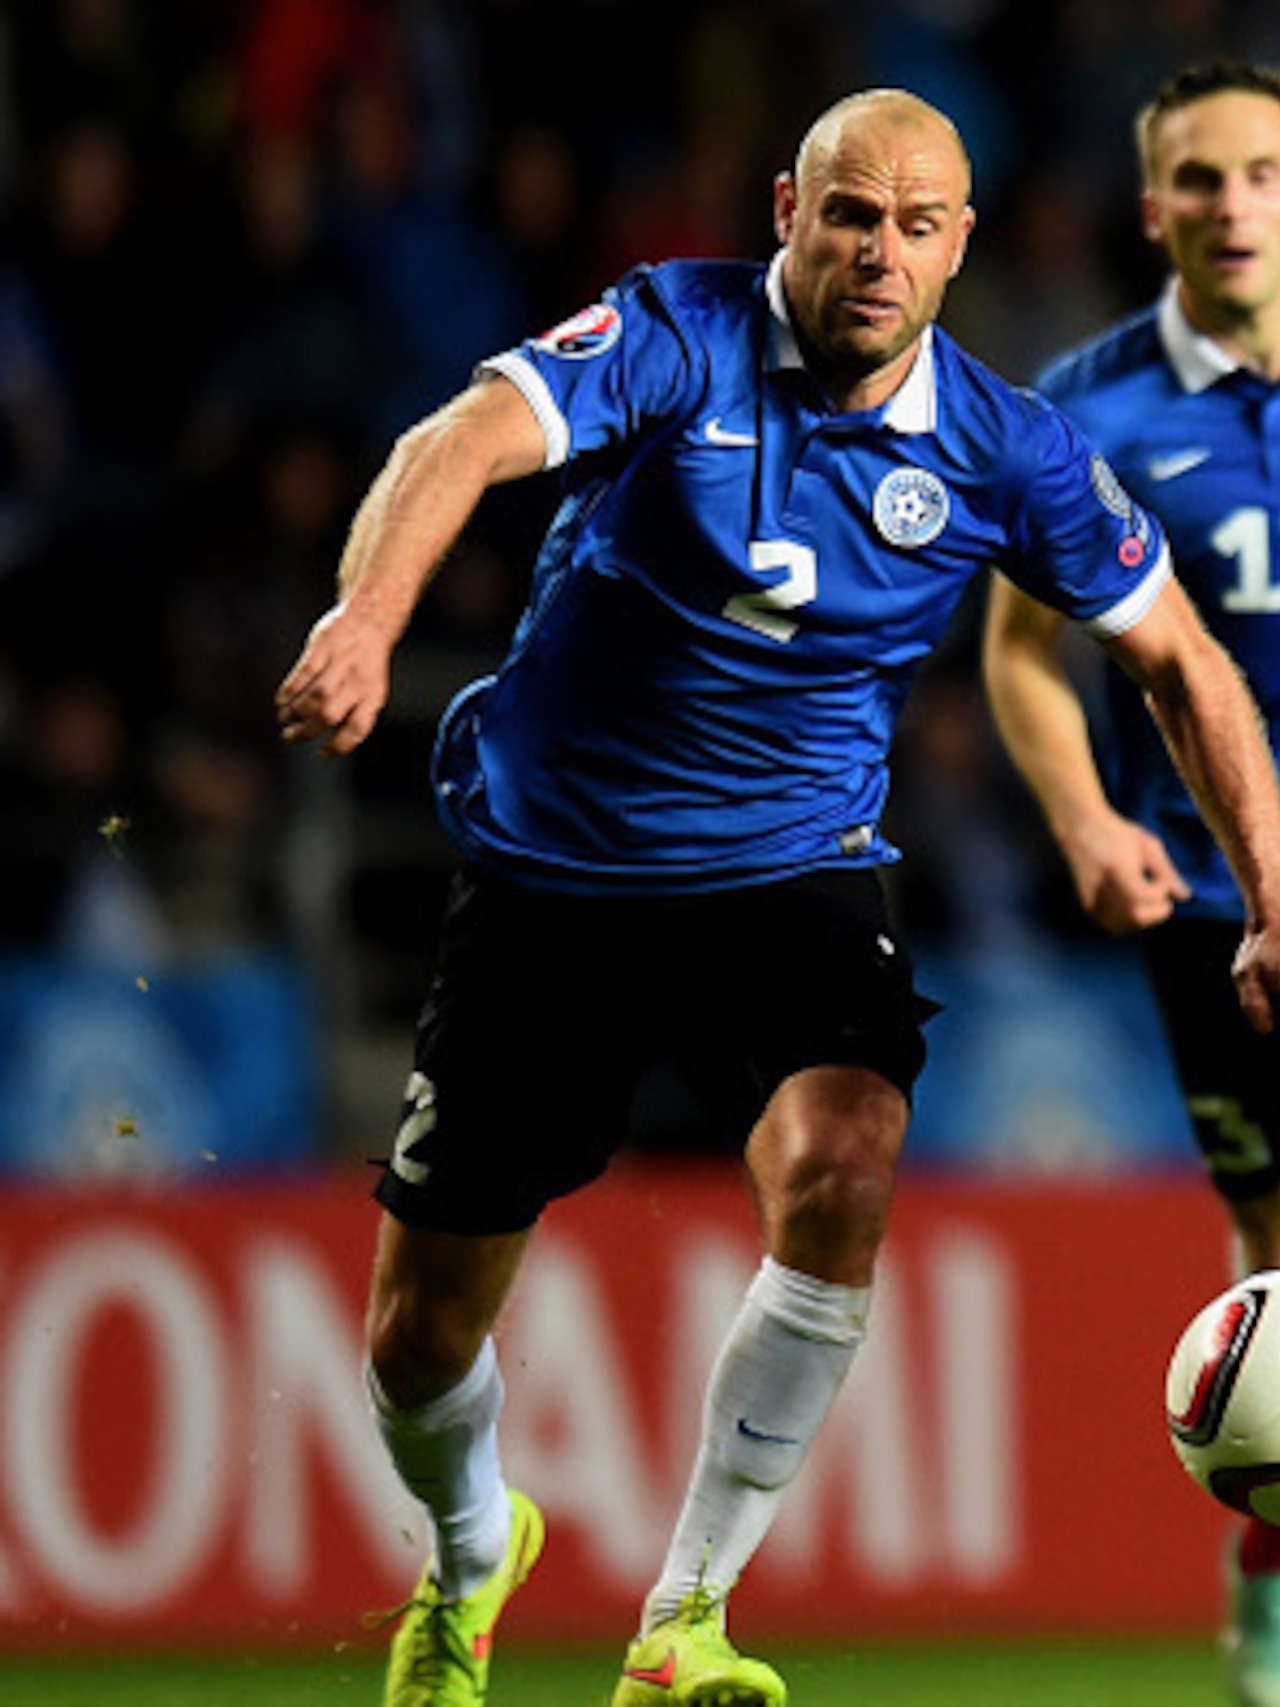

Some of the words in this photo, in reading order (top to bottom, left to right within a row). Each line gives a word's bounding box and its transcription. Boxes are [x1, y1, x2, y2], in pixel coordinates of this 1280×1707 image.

[722, 538, 817, 645] 2
[391, 1071, 437, 1184] 2
[0, 1226, 1022, 1608] ONAMI
